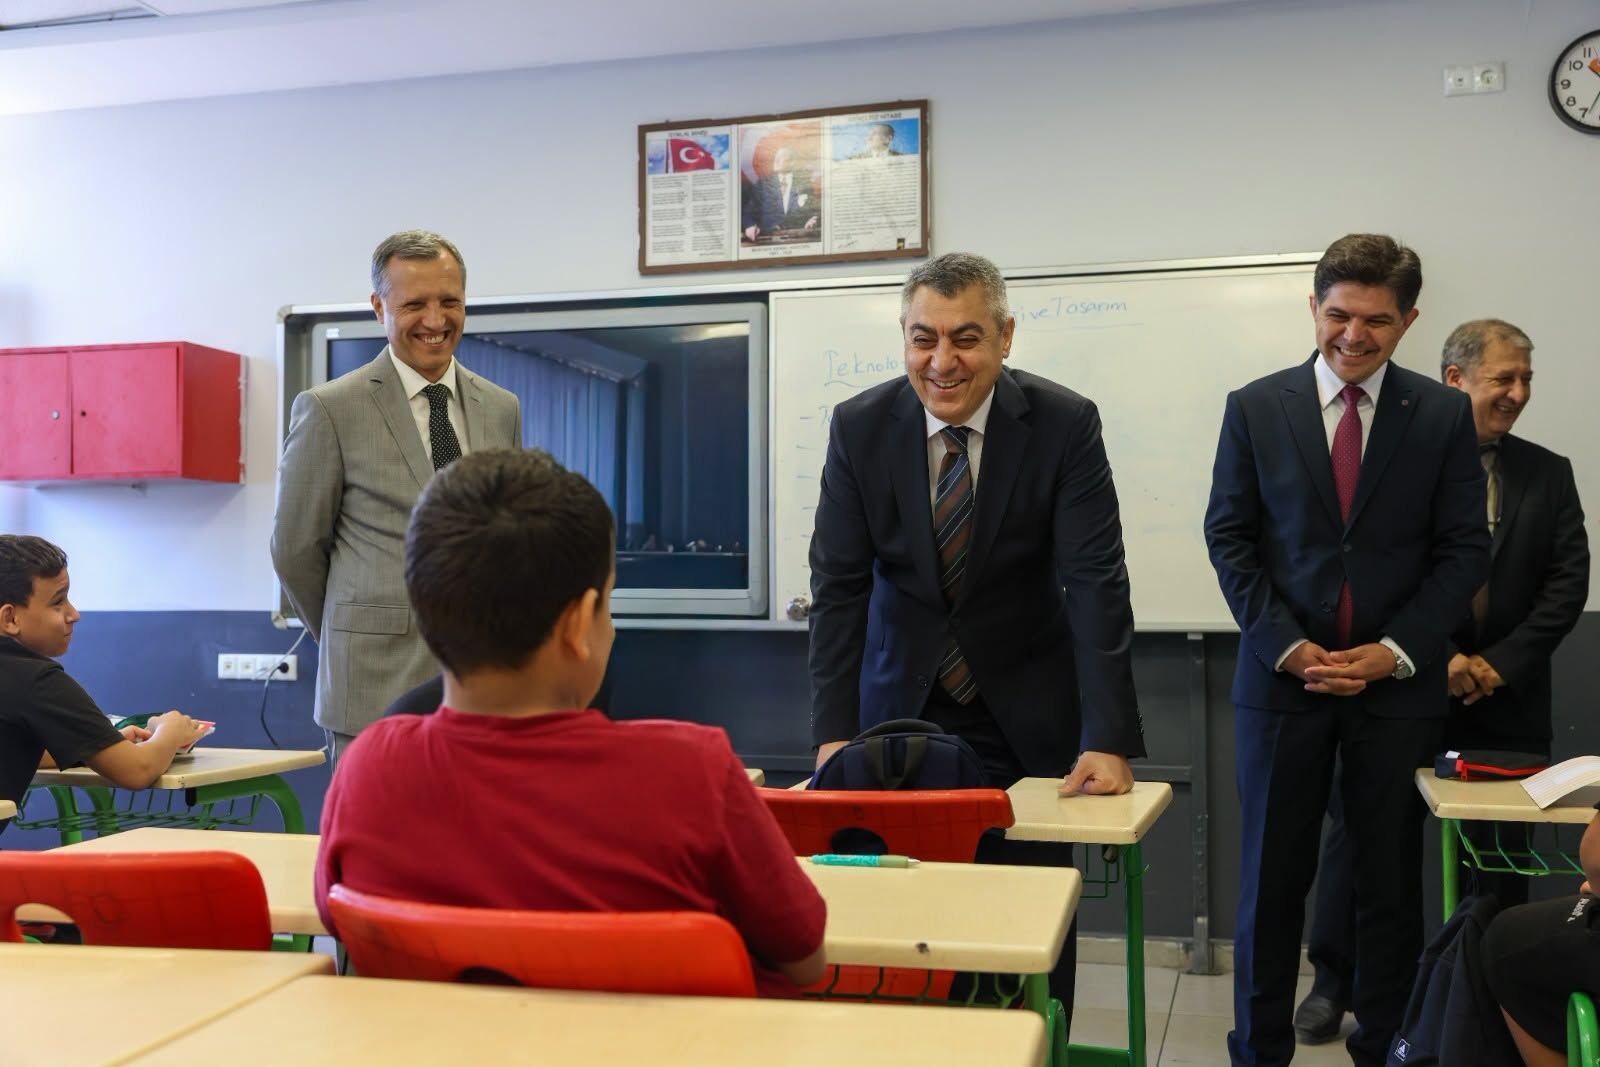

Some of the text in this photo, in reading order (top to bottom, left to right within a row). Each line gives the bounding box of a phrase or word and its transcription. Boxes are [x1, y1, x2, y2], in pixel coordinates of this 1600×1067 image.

[1583, 47, 1591, 58] 11
[1569, 60, 1583, 71] 10
[1560, 79, 1571, 89] 9
[1566, 96, 1576, 107] 8
[1579, 107, 1588, 118] 7
[824, 349, 905, 379] Teknolo
